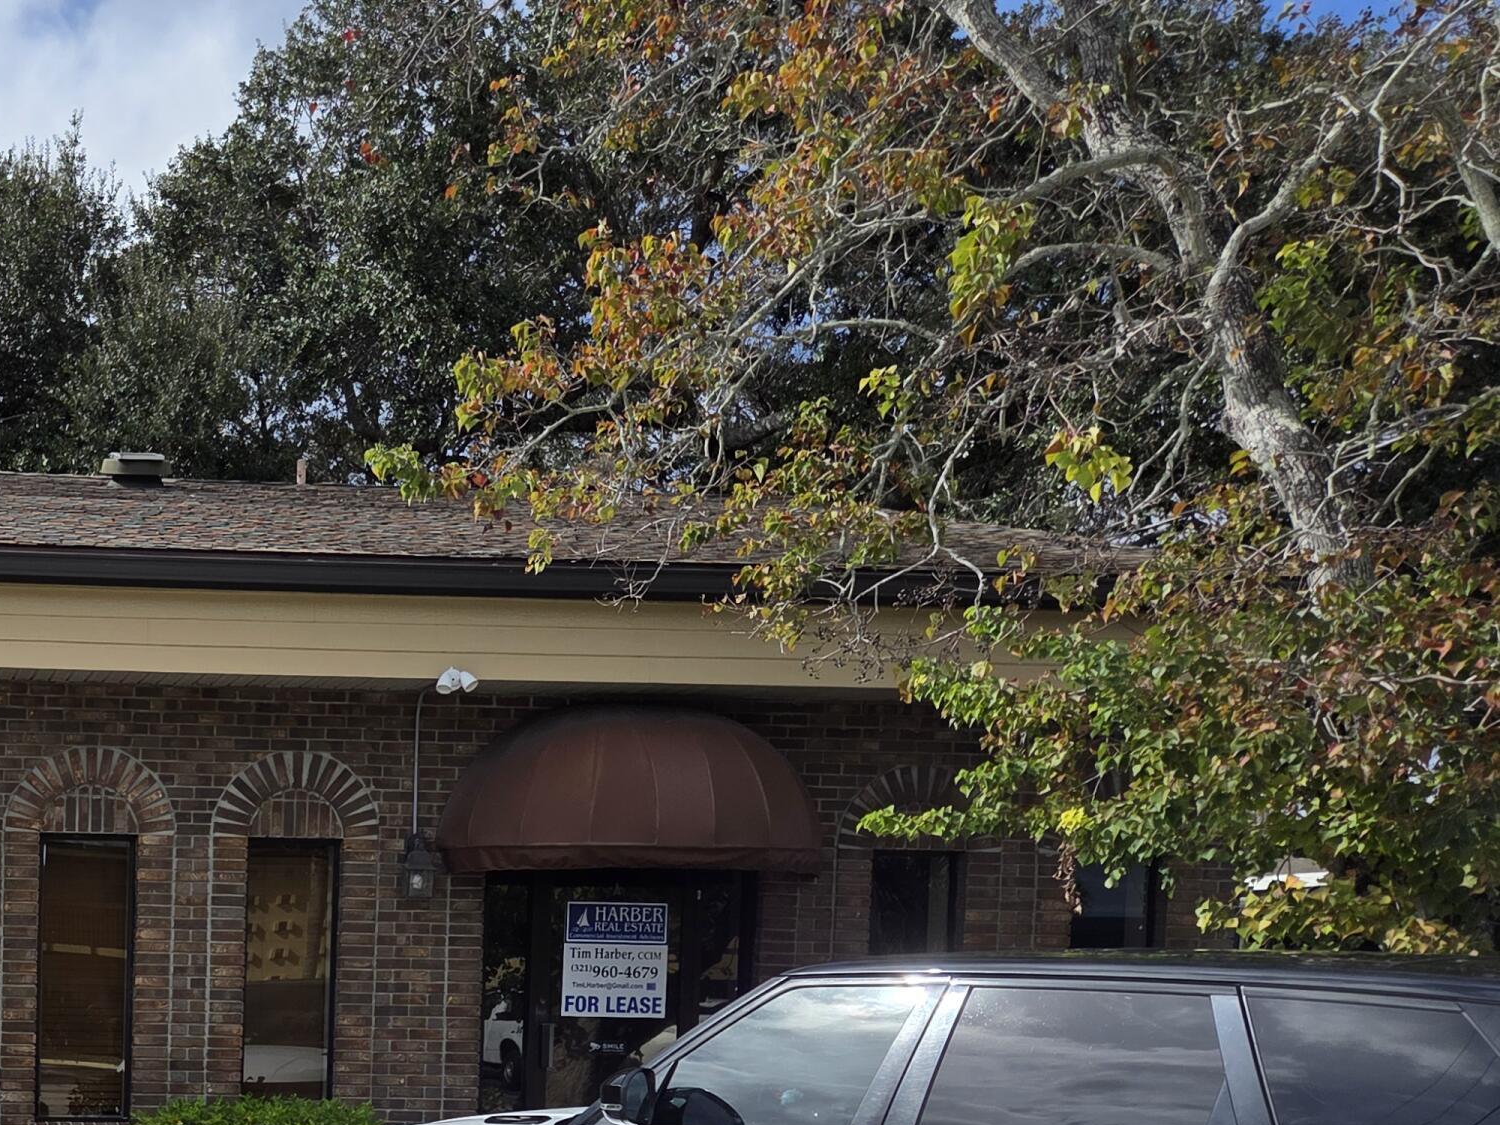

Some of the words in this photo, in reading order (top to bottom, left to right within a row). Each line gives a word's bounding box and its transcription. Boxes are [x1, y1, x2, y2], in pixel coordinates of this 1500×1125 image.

[595, 906, 664, 922] HARBER
[594, 922, 621, 933] REAL
[624, 922, 664, 934] ESTATE
[569, 947, 591, 959] Tim
[594, 948, 635, 961] Harber,
[638, 952, 662, 960] CCIM
[564, 995, 599, 1013] FOR
[606, 996, 662, 1014] LEASE
